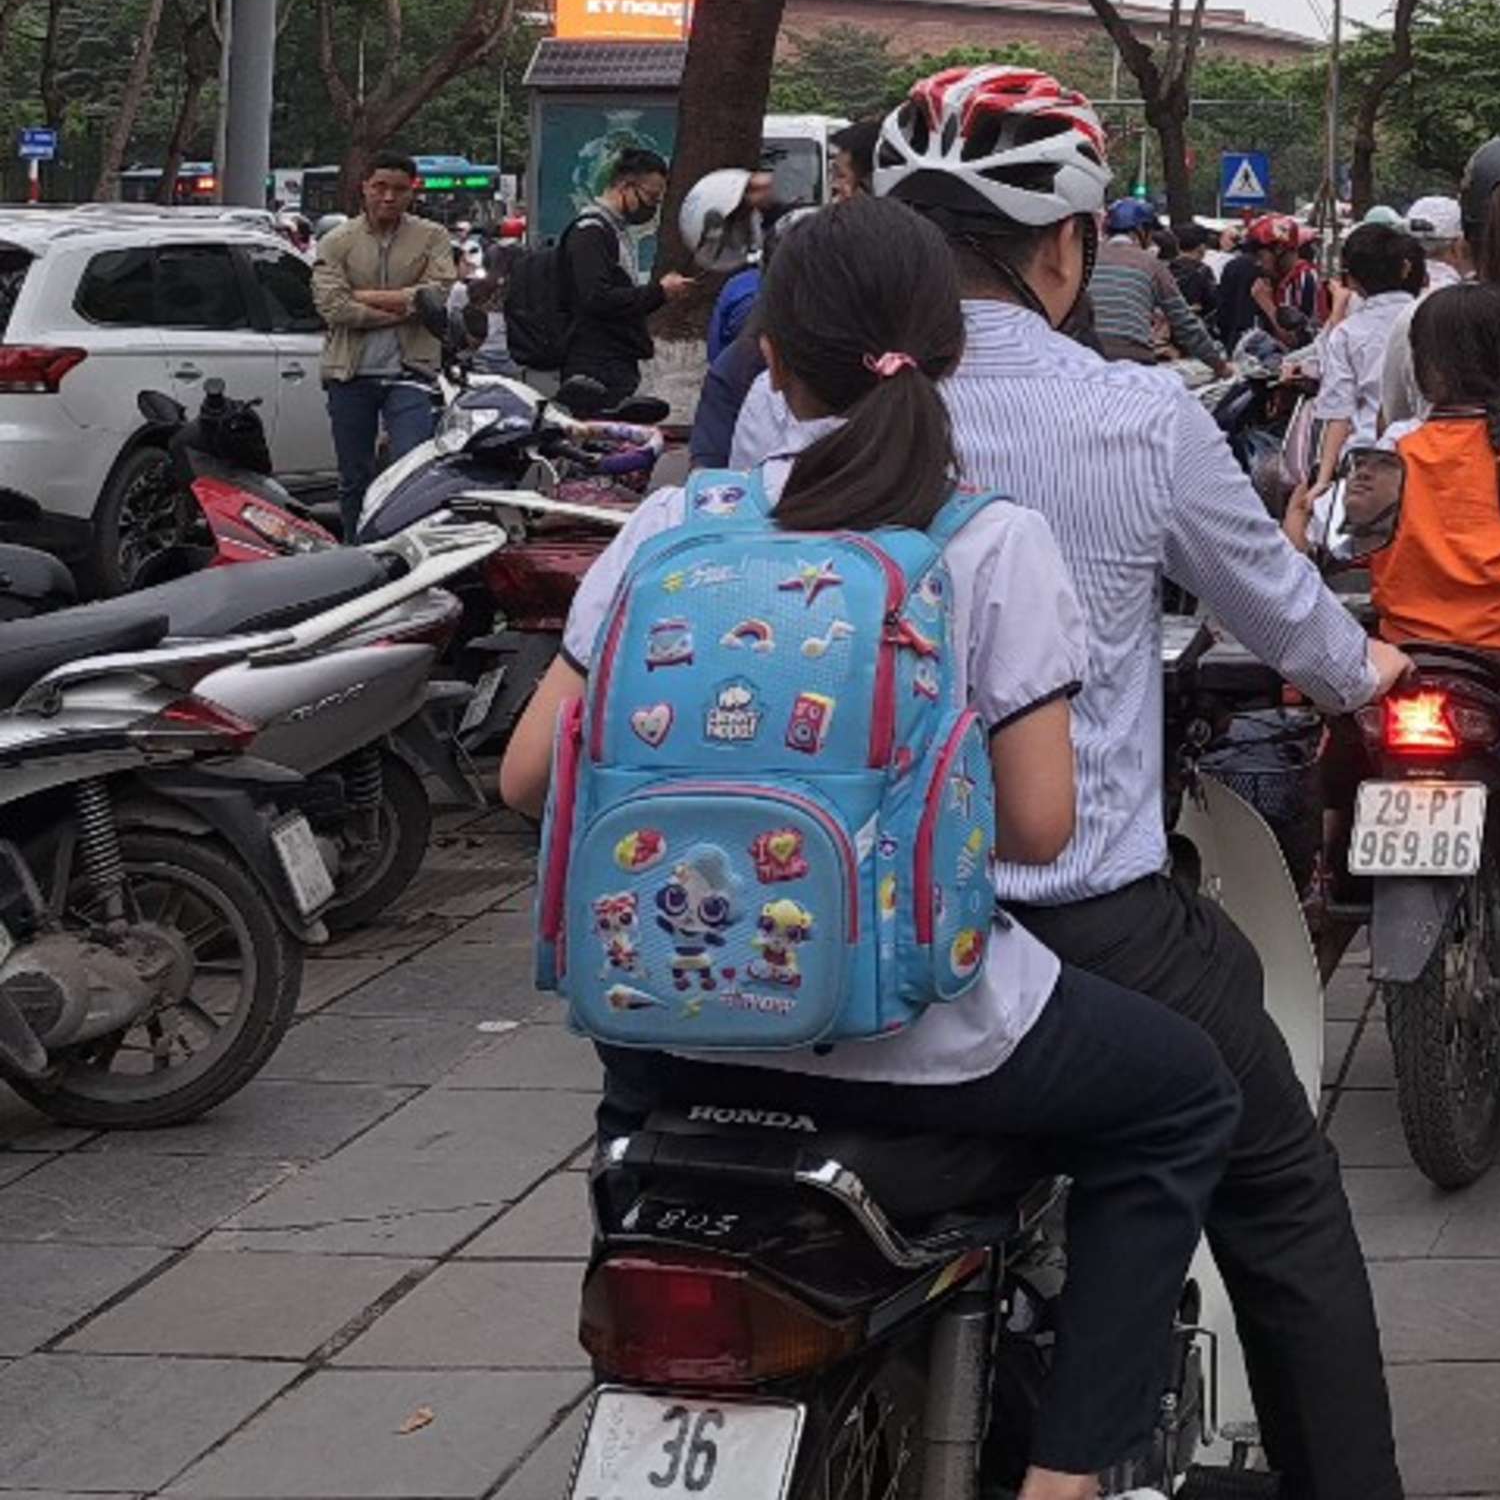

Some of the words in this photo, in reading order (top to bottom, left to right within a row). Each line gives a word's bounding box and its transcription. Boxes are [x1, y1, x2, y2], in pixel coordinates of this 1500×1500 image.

[1375, 789, 1465, 826] 29-P1
[1360, 830, 1471, 868] 969.86
[687, 1105, 818, 1132] HONDA
[648, 1405, 724, 1491] 36
